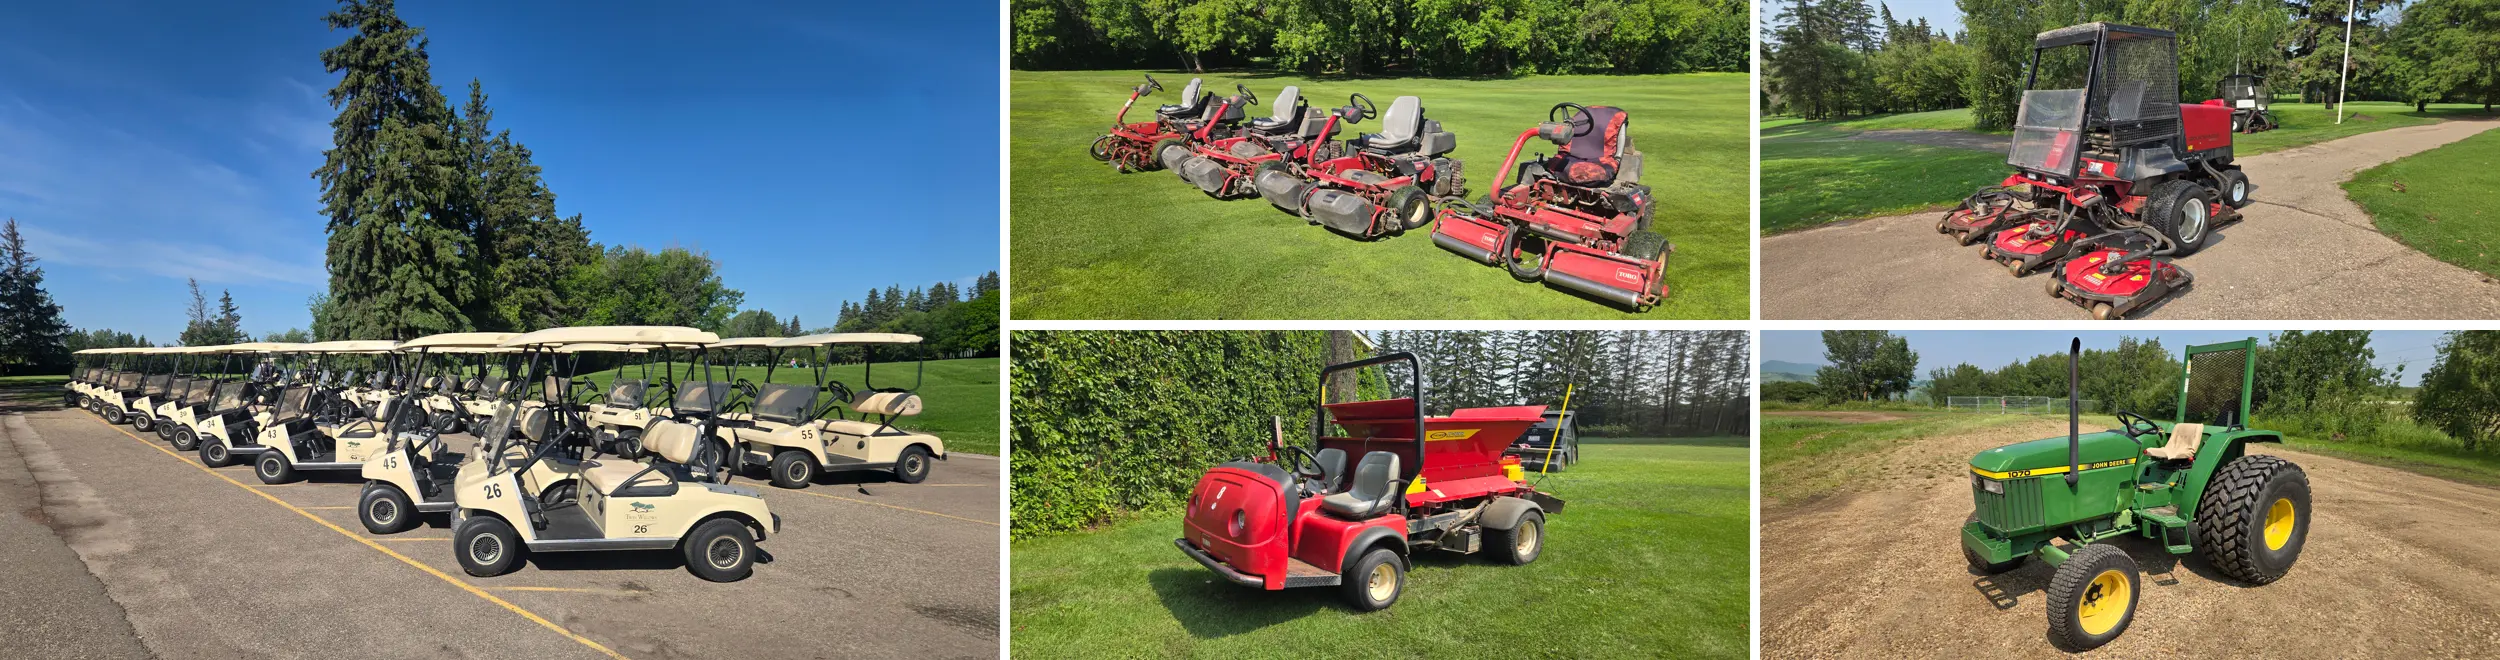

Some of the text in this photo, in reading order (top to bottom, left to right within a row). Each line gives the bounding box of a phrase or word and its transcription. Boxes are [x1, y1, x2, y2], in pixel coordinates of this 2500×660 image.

[1619, 271, 1637, 280] TORO
[207, 420, 215, 428] 34
[267, 429, 277, 439] 43
[801, 430, 813, 440] 55
[383, 457, 397, 470] 45
[2007, 470, 2031, 478] 1070
[484, 483, 502, 500] 26
[1216, 486, 1227, 500] 8
[634, 524, 648, 534] 26
